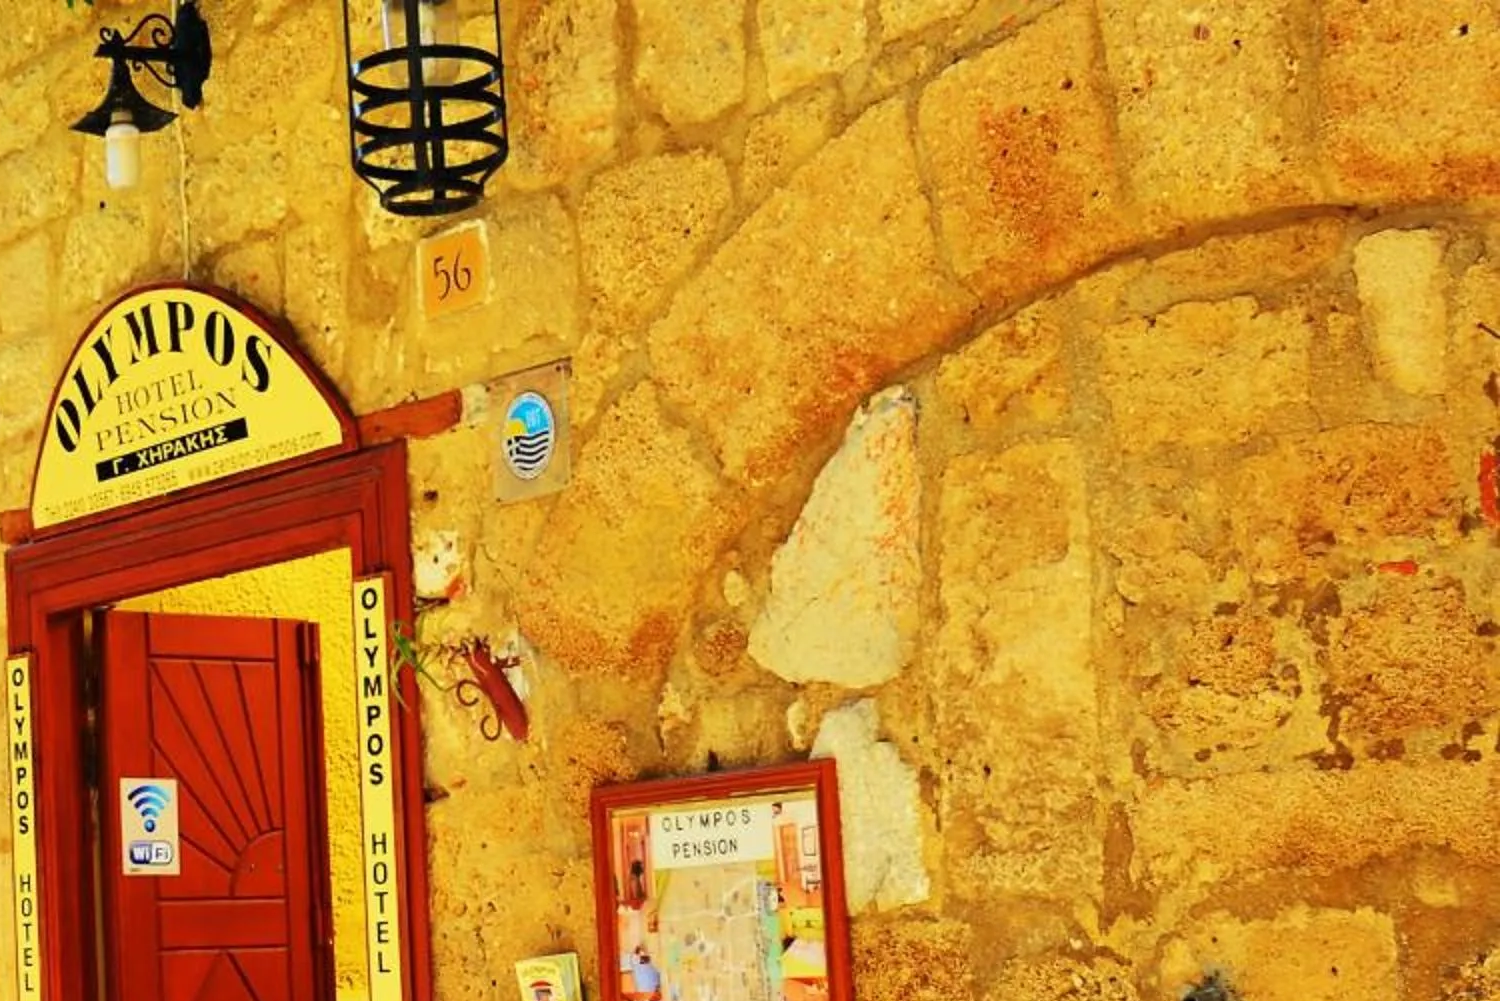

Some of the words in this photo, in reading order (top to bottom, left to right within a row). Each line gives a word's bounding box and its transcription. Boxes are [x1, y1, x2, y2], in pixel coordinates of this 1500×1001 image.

[433, 249, 473, 302] 56
[55, 300, 272, 454] OLYMPOS
[115, 369, 204, 415] HOTEL
[96, 386, 237, 452] PENSION
[136, 425, 229, 469] ΧΗΡΑΚΗΣ
[360, 587, 384, 786] OLYMPOS
[11, 667, 29, 836] OLYMPOS
[661, 808, 752, 833] OLYMPOS
[671, 838, 738, 859] PENSION
[19, 873, 35, 993] HOTEL
[371, 832, 391, 974] HOTEL
